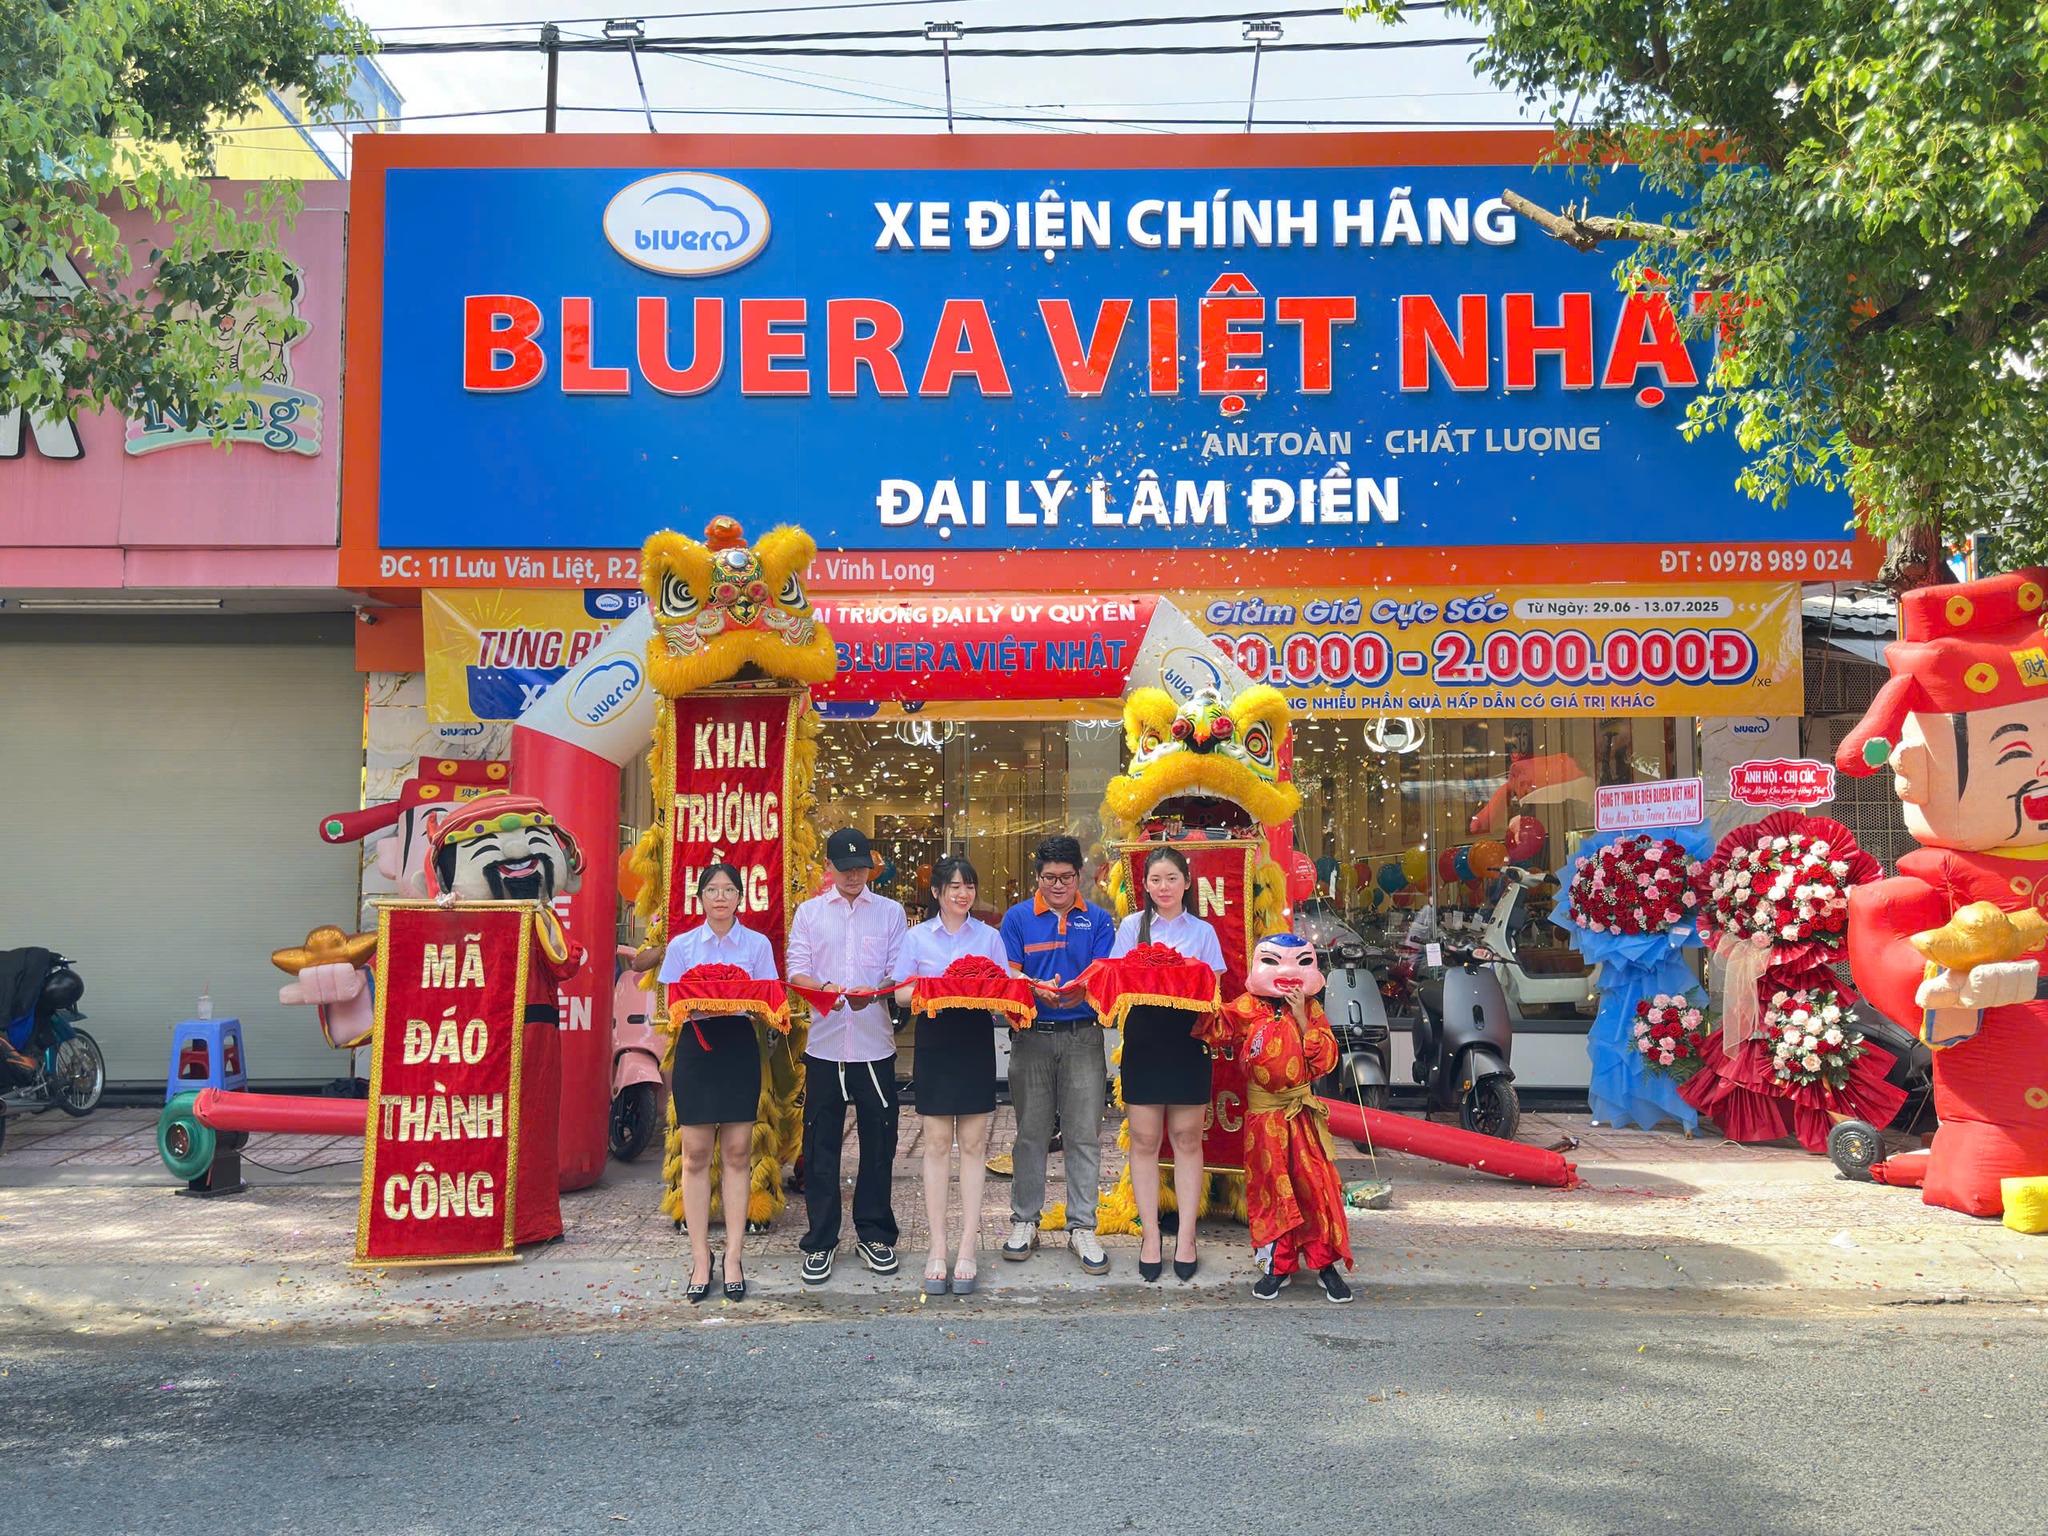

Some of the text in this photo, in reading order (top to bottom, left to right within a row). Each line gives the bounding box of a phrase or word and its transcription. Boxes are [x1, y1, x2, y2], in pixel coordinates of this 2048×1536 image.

[634, 229, 734, 251] bluera
[874, 186, 1516, 263] XE ĐIỆN CHÍNH HÃNG
[463, 294, 1013, 397] BLUERA
[1037, 273, 1357, 416] VIỆT
[1201, 432, 1248, 456] AN
[1258, 426, 1351, 456] TOÀN
[1385, 421, 1477, 453] CHẤT
[876, 461, 1399, 540] ĐẠI LÝ LÂM ĐIỀN
[380, 555, 420, 578] ĐC:
[428, 556, 449, 578] 11
[455, 556, 496, 578] Lưu
[504, 556, 545, 579] Văn
[552, 556, 600, 584] Liệt,
[825, 557, 875, 580] Vĩnh
[881, 558, 935, 587] Long
[1709, 550, 1763, 572] 0978
[1767, 549, 1808, 572] 989
[1813, 548, 1853, 571] 024
[977, 604, 1005, 623] LÝ
[1206, 592, 1509, 630] Giảm Giá Cực Sốc
[1528, 602, 1544, 613] Từ
[1548, 602, 1588, 616] Ngày:
[1593, 602, 1631, 613] 29.06
[1644, 602, 1719, 612] 13.07.2025
[834, 632, 1127, 676] BLUERA VIỆT NHẬT
[1434, 630, 1754, 684] 2.000.000Đ
[1751, 675, 1772, 687] /xe
[586, 678, 637, 723] bluera
[1313, 690, 1357, 709] NHIỀU
[1362, 691, 1403, 709] PHẦN
[1408, 693, 1441, 709] QUÀ
[1447, 691, 1478, 709] HẤP
[1483, 691, 1516, 708] DẪN
[1550, 693, 1576, 708] GIÁ
[1584, 696, 1605, 711] TRỊ
[1611, 693, 1656, 708] KHÁC
[694, 721, 767, 769] KHAI
[1734, 725, 1765, 733] bluera
[1744, 770, 1761, 783] ANH
[1763, 768, 1778, 785] HỘI
[1784, 770, 1798, 785] CHỊ
[1800, 768, 1816, 783] CÚC
[675, 782, 779, 844] TRƯƠNG
[1600, 791, 1613, 808] CÔNG
[1614, 792, 1620, 807] TY
[1622, 790, 1633, 806] TNHH
[1634, 790, 1640, 805] XE
[1653, 787, 1671, 804] BLUERA
[421, 932, 485, 989] MÃ
[402, 1005, 488, 1065] ĐÁO
[379, 1080, 503, 1142] THÀNH
[383, 1162, 494, 1221] CÔNG
